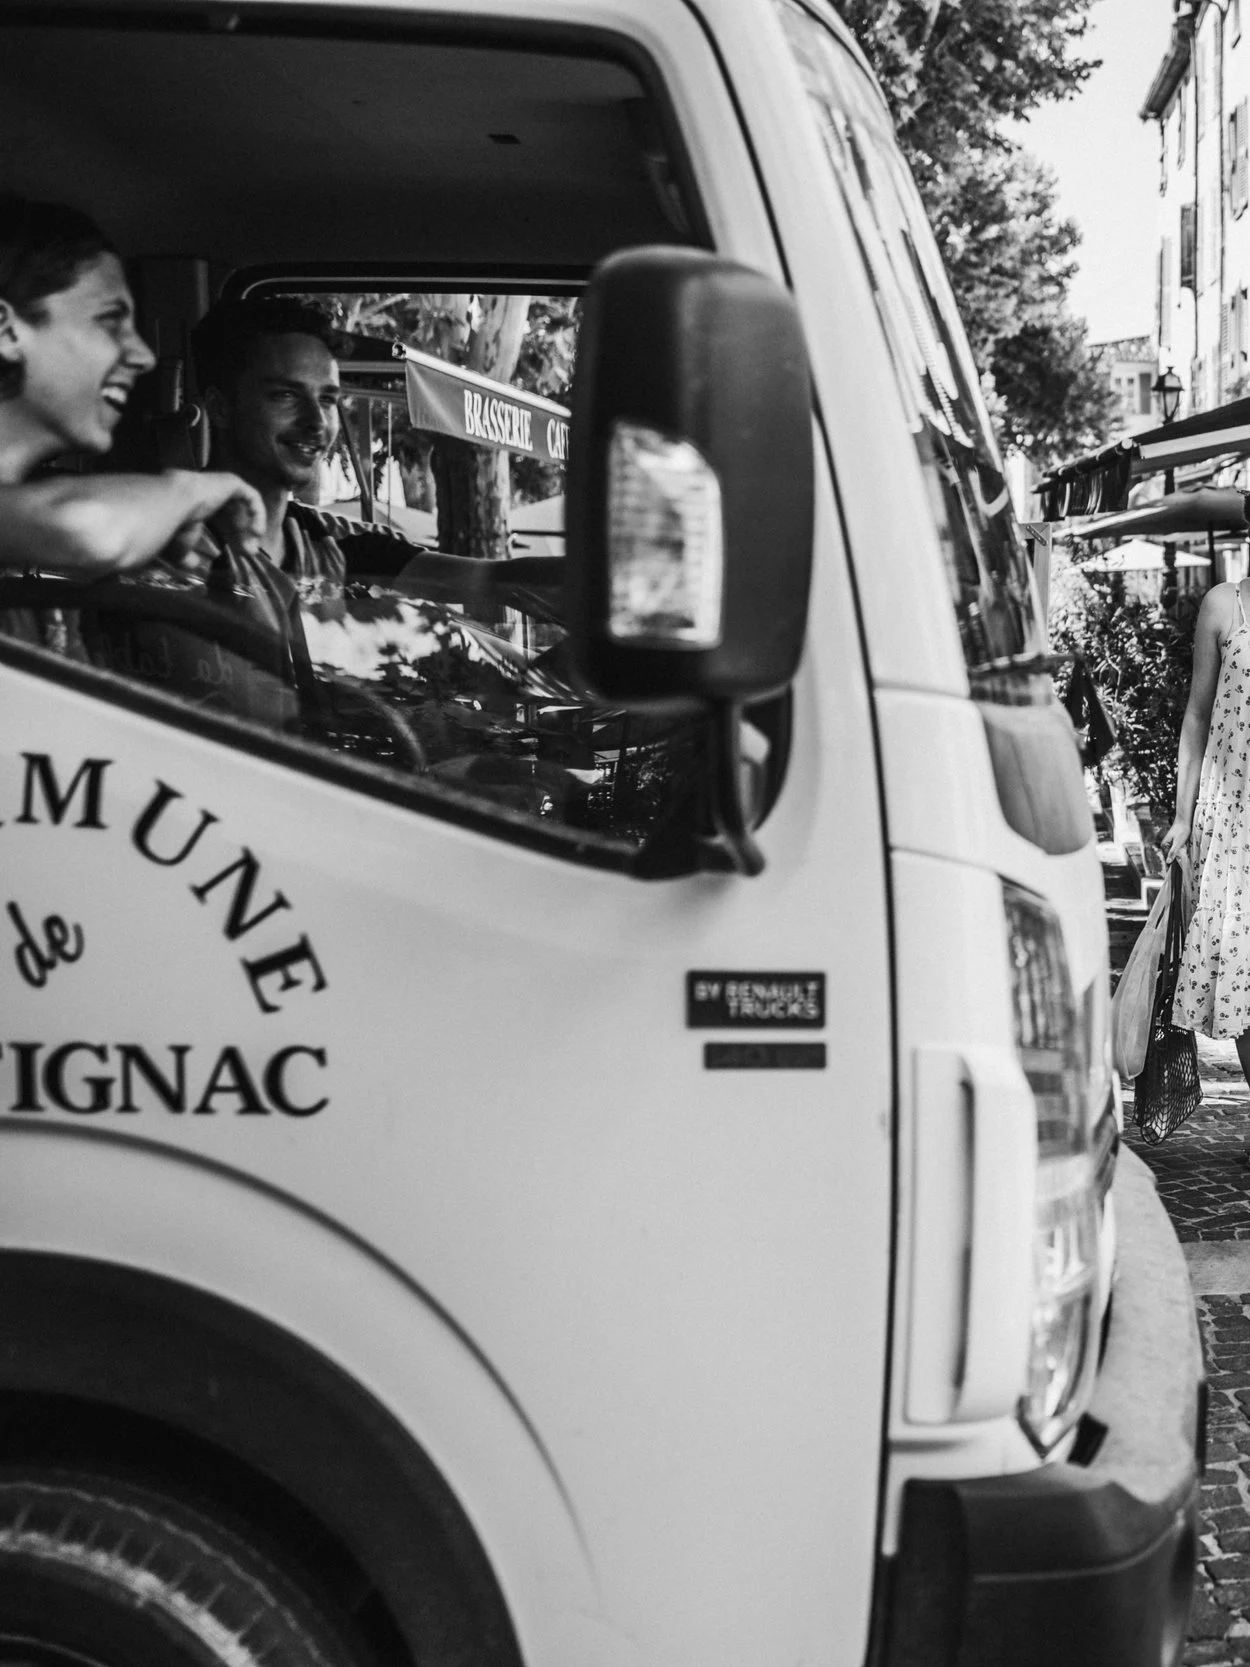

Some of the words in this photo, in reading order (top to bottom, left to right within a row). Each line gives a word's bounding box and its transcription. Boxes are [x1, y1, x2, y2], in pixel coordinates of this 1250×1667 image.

[464, 389, 533, 451] BRASSERIE
[0, 751, 328, 1015] MUNE
[7, 901, 85, 988] de
[729, 1001, 819, 1019] TRUCKS
